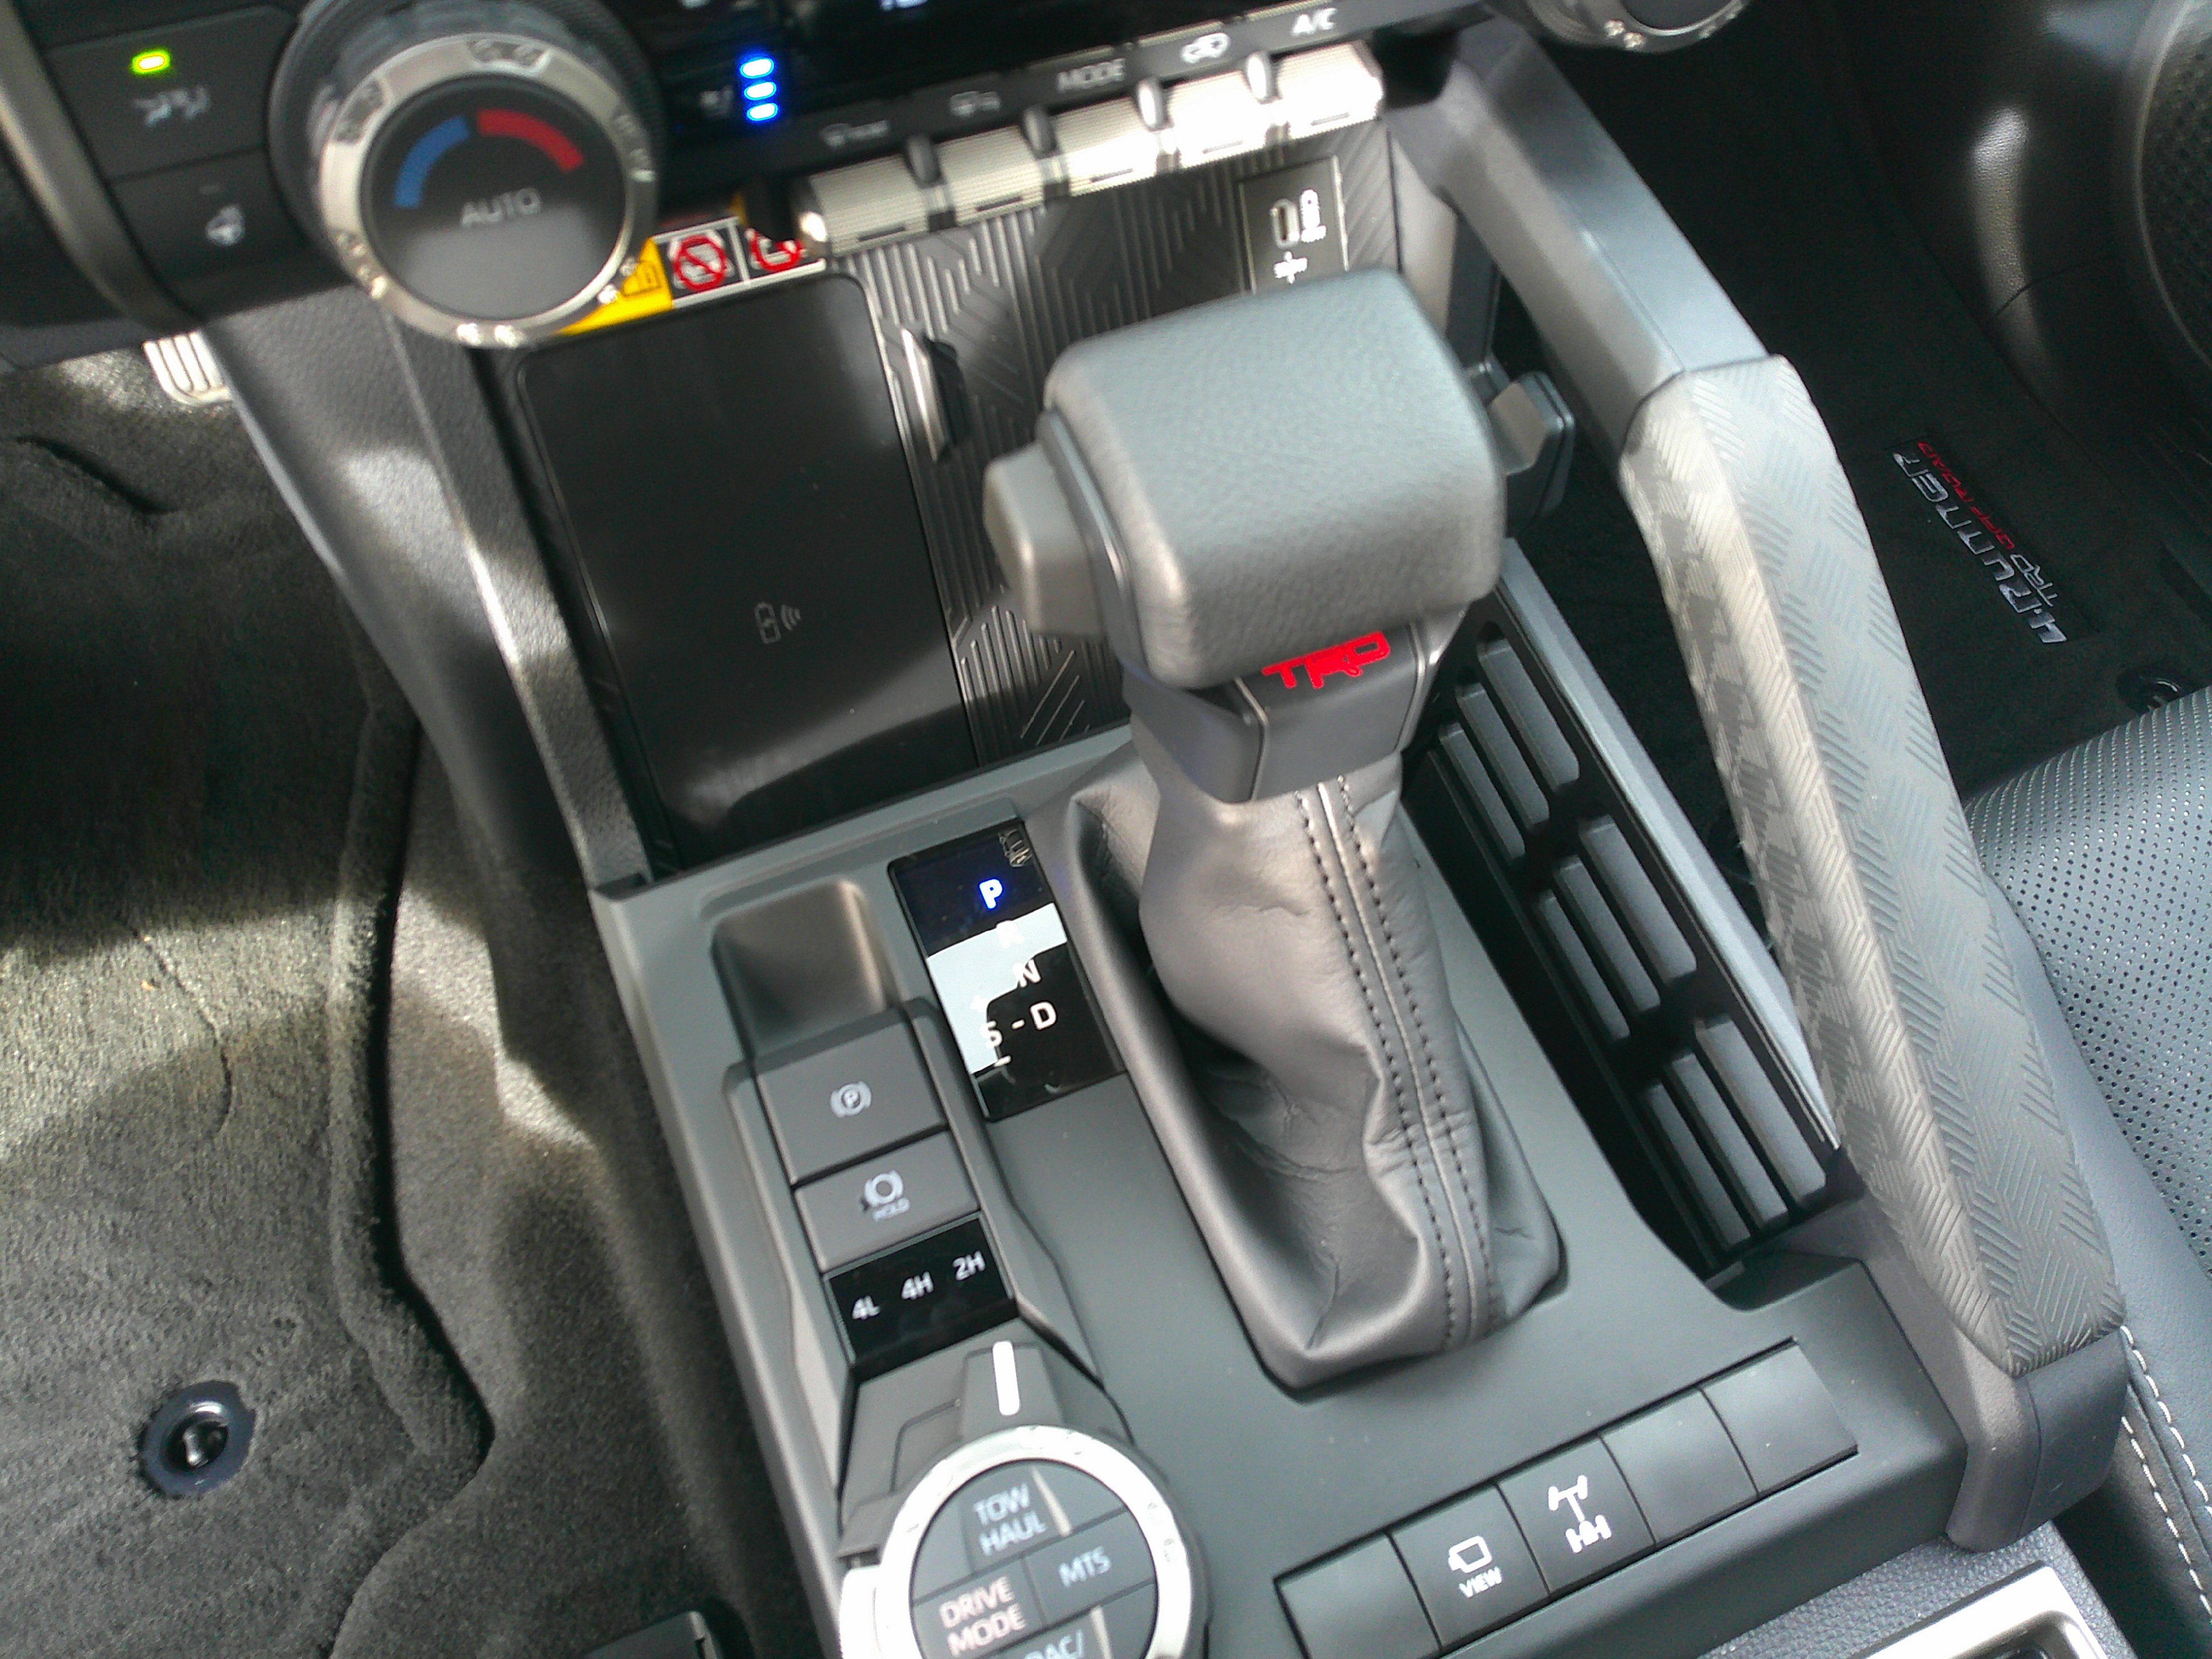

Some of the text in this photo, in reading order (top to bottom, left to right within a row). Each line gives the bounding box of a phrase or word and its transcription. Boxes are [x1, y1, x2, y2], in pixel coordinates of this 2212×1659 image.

[1292, 7, 1337, 36] A/C
[1058, 58, 1126, 93] MODE
[461, 187, 542, 227] AUTO
[2009, 553, 2058, 607] TRD
[1261, 630, 1391, 689] TRD
[979, 878, 1004, 909] P
[1012, 958, 1042, 988] N
[1029, 1001, 1057, 1031] D
[851, 1250, 987, 1320] 4L 4H 2H
[973, 1482, 1031, 1526] TOW
[978, 1510, 1047, 1556] HAUL
[1057, 1546, 1112, 1589] MTS
[1458, 1566, 1503, 1599] VIEW
[939, 1576, 1014, 1630] DRIVE
[946, 1605, 1027, 1657] MODE
